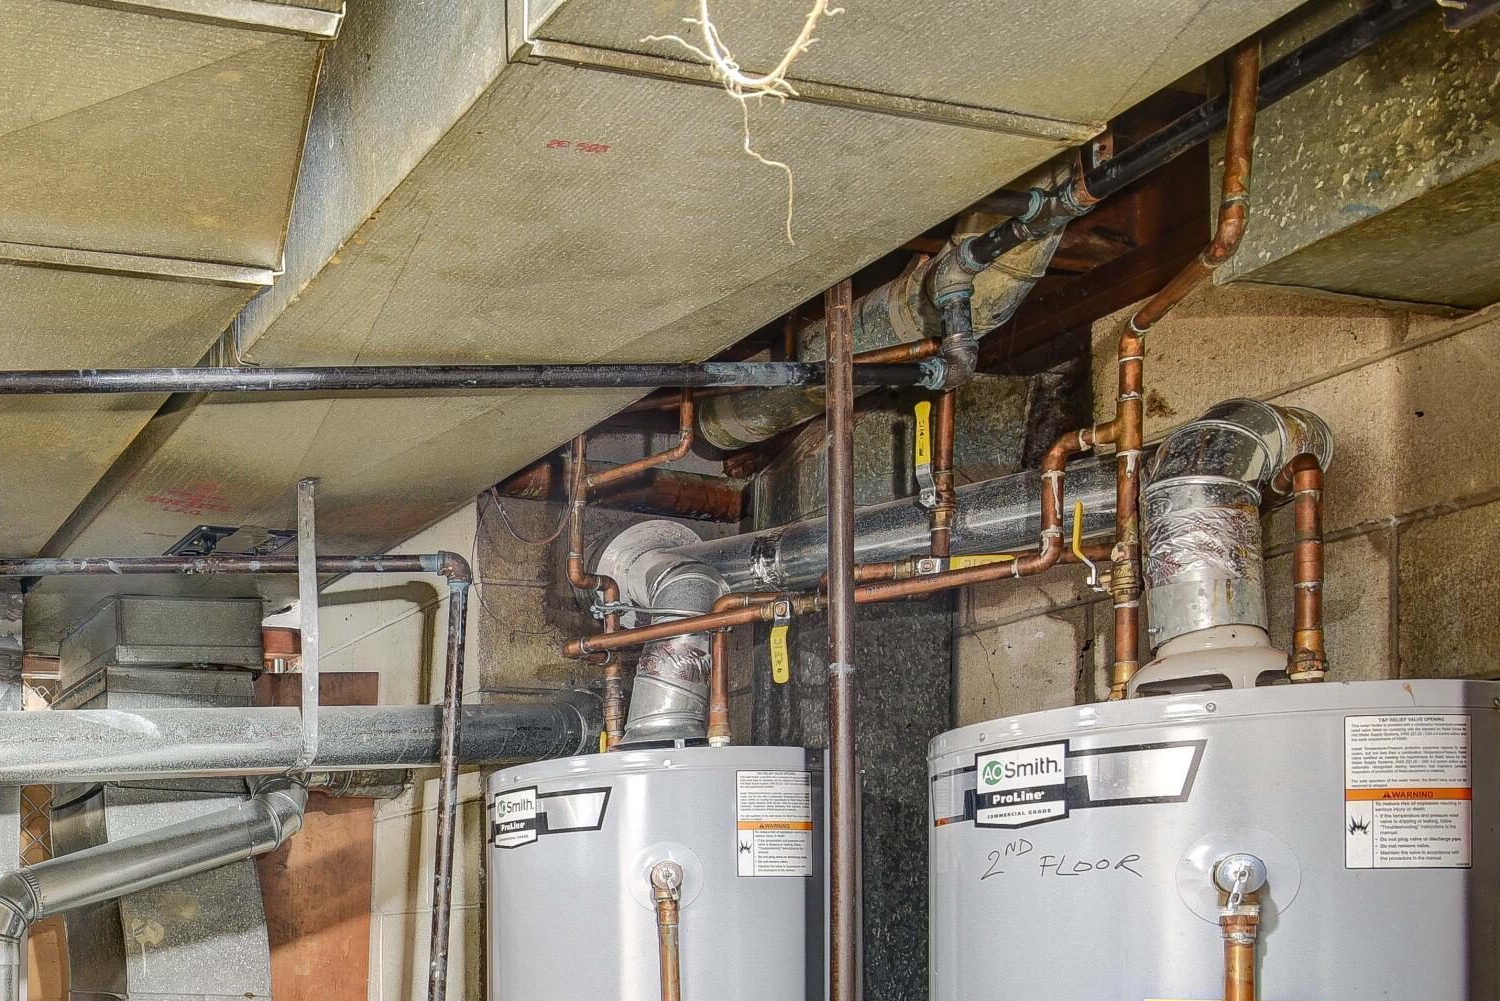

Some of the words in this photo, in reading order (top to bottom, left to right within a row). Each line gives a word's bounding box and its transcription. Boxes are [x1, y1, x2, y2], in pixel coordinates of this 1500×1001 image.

[1391, 791, 1434, 799] WARNING
[987, 810, 1026, 820] COMMERCIAL
[1028, 808, 1052, 817] GRADE
[980, 838, 1034, 881] 2ND
[1040, 854, 1143, 878] FLOOR
